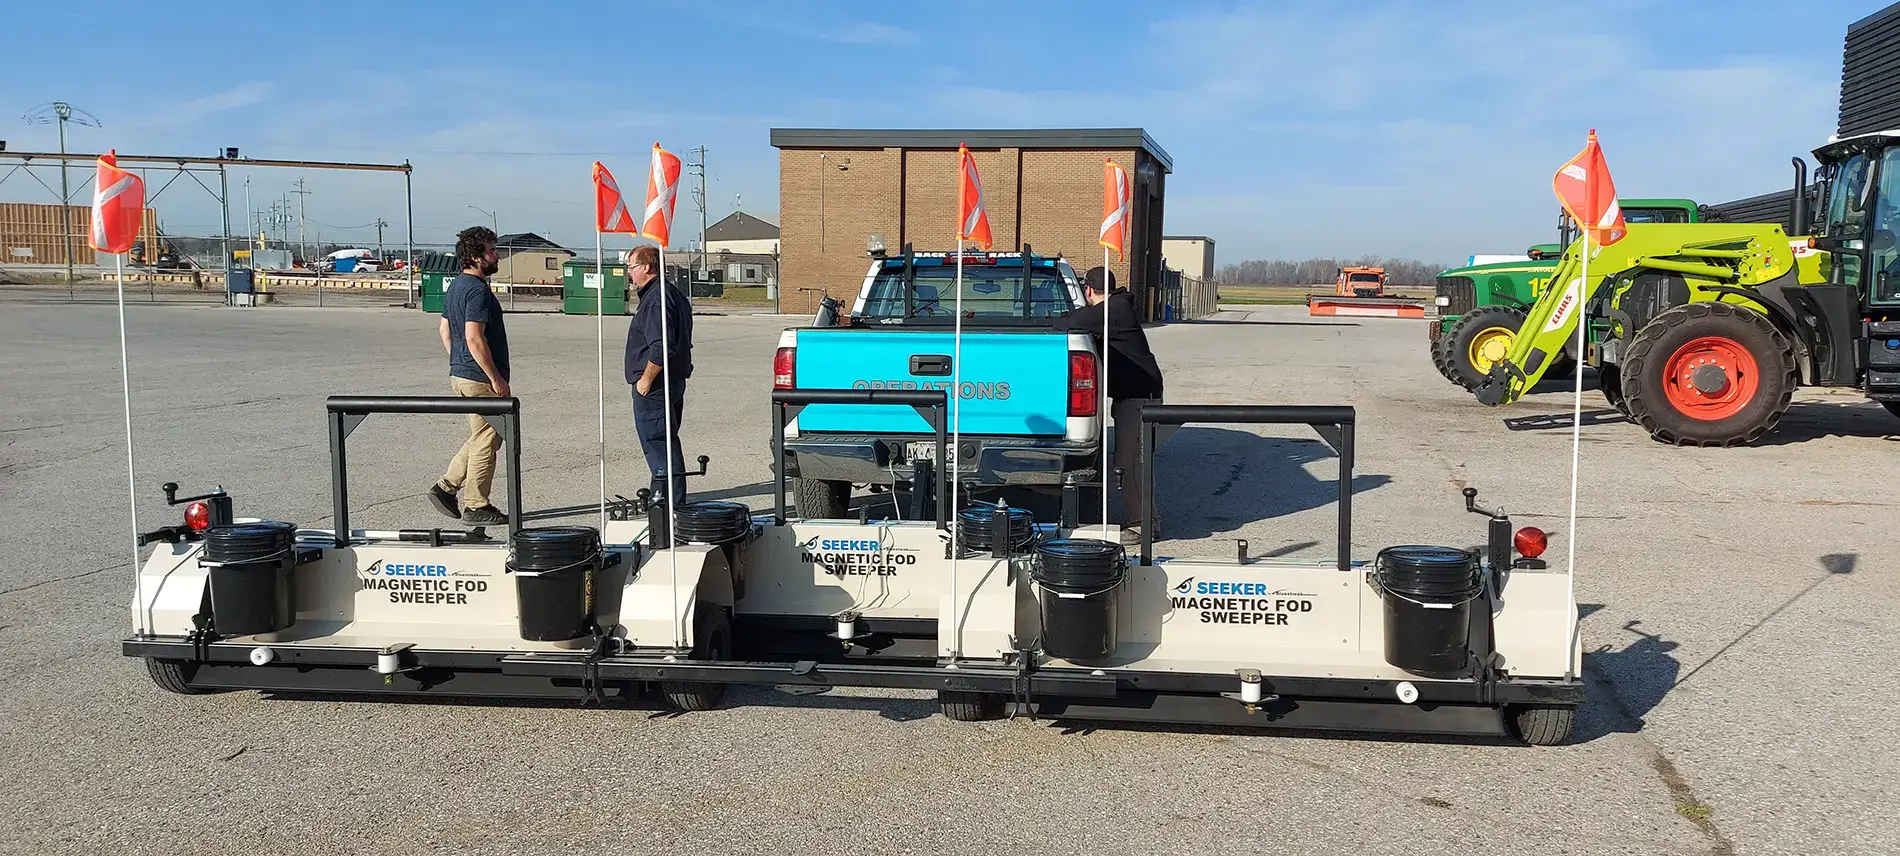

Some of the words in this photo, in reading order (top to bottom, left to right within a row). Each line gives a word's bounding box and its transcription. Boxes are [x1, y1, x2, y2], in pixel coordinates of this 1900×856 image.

[1551, 293, 1573, 325] CLAAS
[821, 539, 880, 551] SEEKER
[801, 552, 881, 565] MAGNETIC
[886, 554, 917, 565] FOD
[385, 563, 447, 577] SEEKER
[825, 565, 898, 576] SWEEPER
[364, 577, 451, 591] MAGNETIC
[455, 579, 488, 592] FOD
[1196, 581, 1267, 596] SEEKER
[389, 591, 468, 605] SWEEPER
[1171, 596, 1269, 611] MAGNETIC
[1275, 599, 1313, 613] FOD
[1200, 611, 1289, 626] SWEEPER
